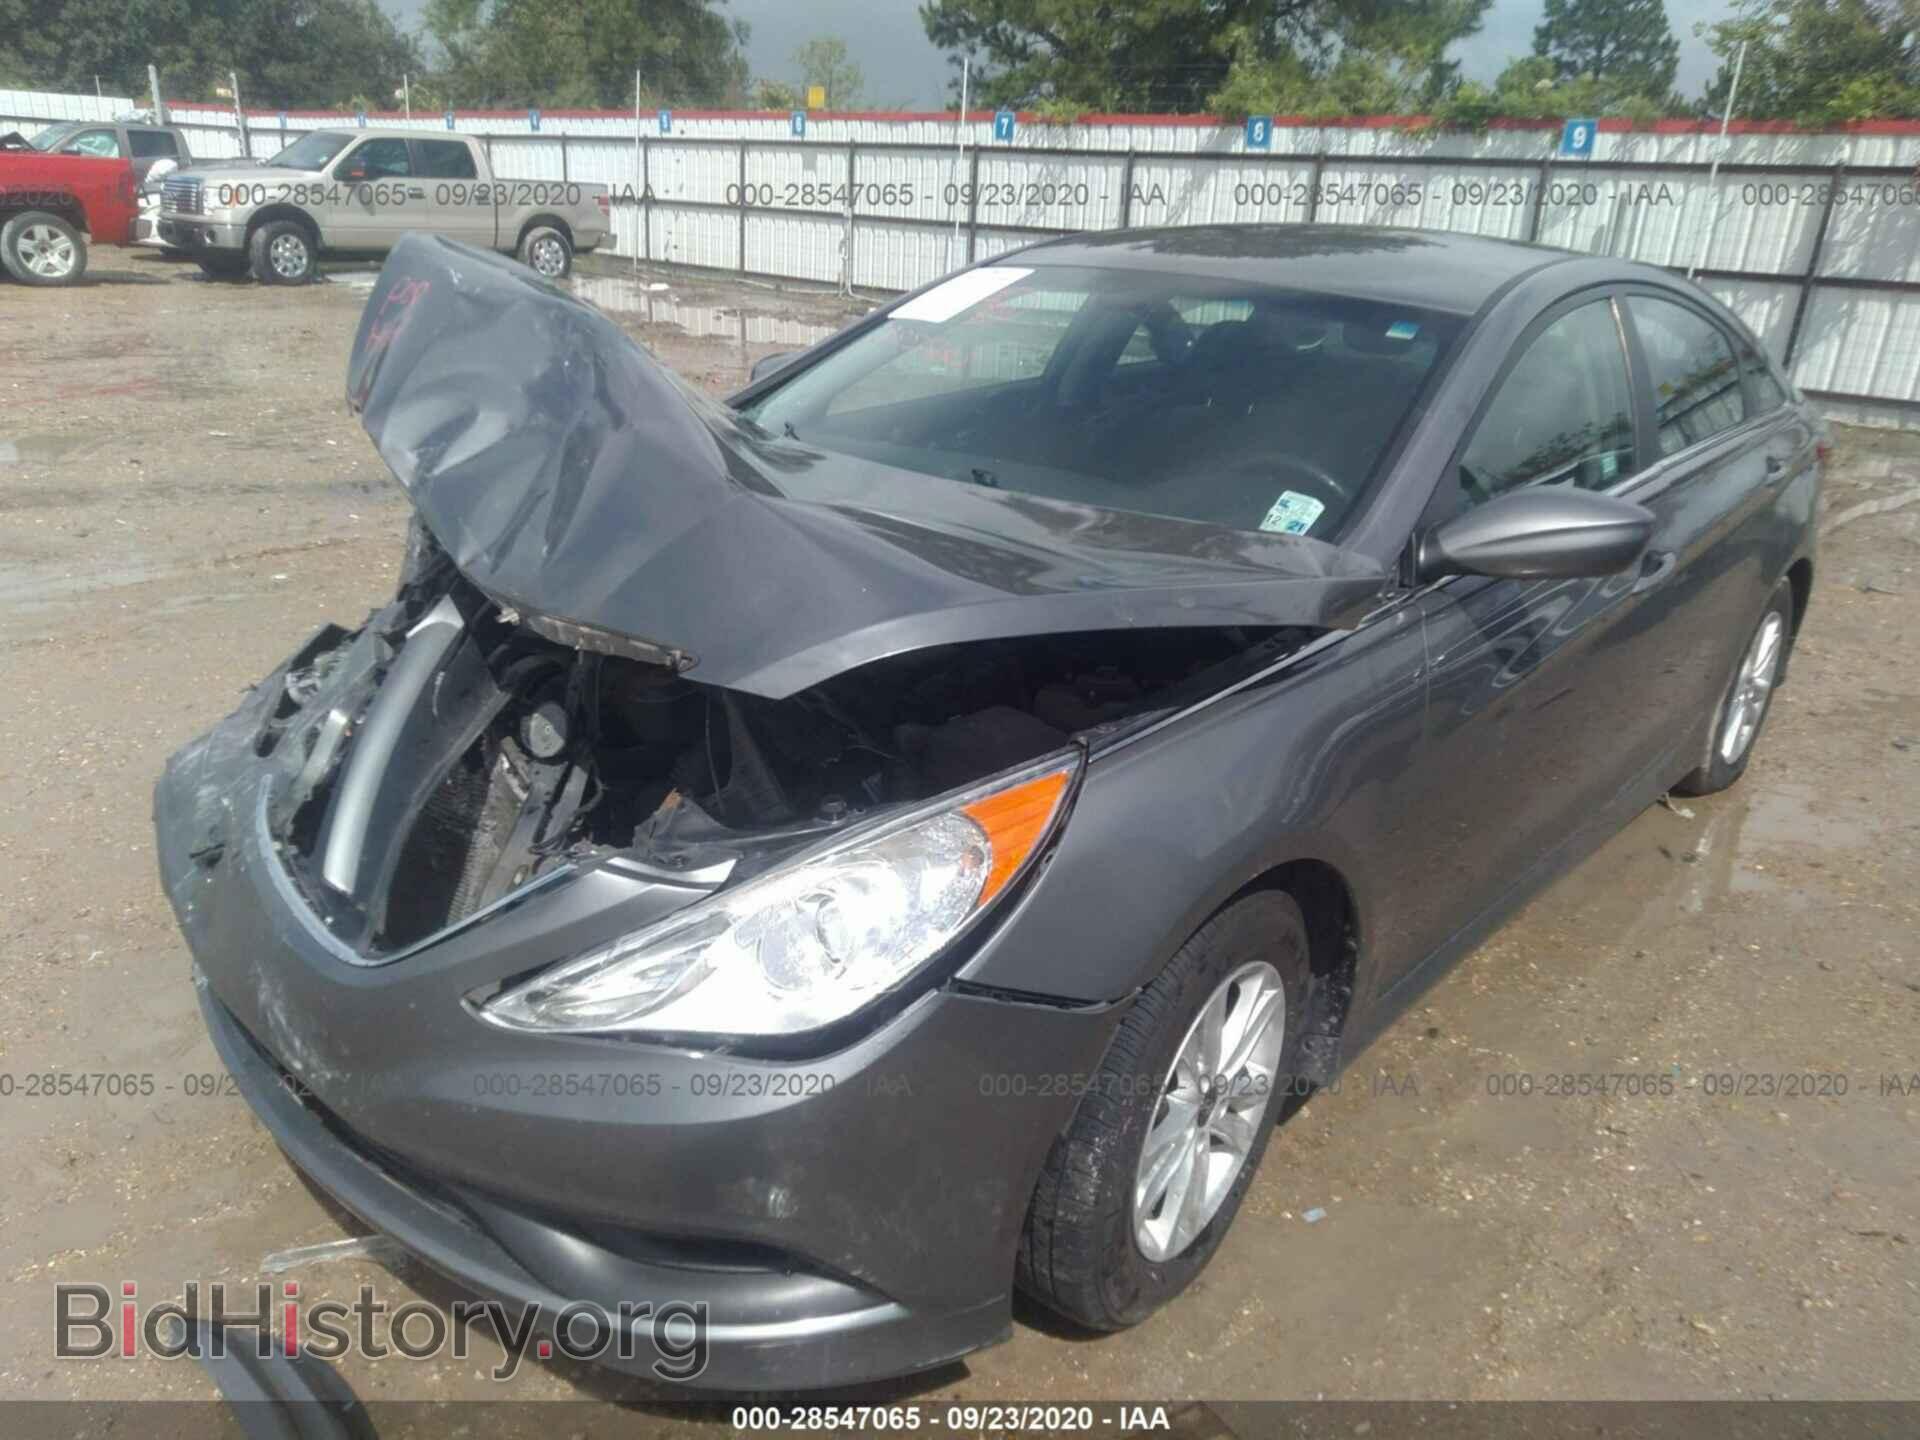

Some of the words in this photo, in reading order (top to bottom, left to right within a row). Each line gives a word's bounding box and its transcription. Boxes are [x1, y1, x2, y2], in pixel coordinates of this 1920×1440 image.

[1000, 117, 1009, 136] 7
[1571, 126, 1588, 149] 9
[1286, 520, 1306, 532] 21
